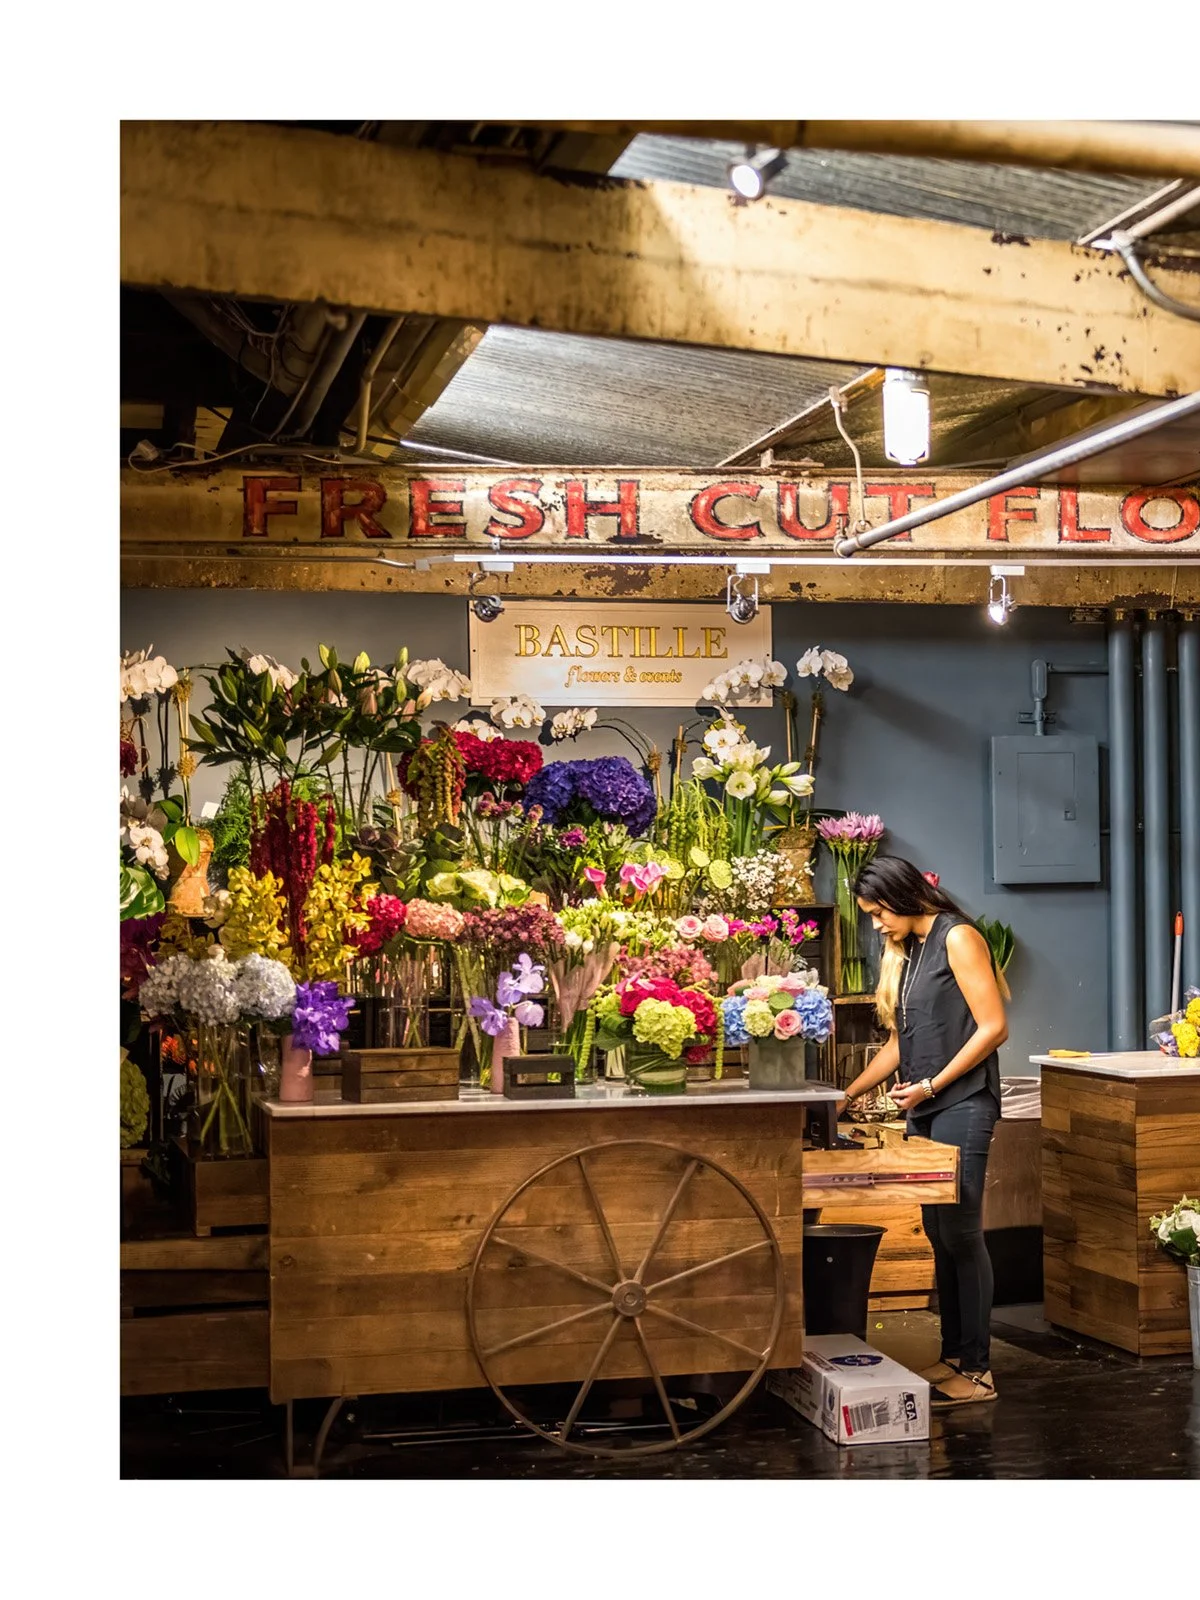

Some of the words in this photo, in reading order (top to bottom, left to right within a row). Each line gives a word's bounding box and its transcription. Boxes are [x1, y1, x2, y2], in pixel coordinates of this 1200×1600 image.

[242, 475, 641, 539] FRESH
[691, 480, 936, 542] CUT
[515, 624, 728, 659] BASTILLE
[564, 665, 620, 688] flowers
[623, 665, 638, 683] &
[639, 667, 683, 683] events
